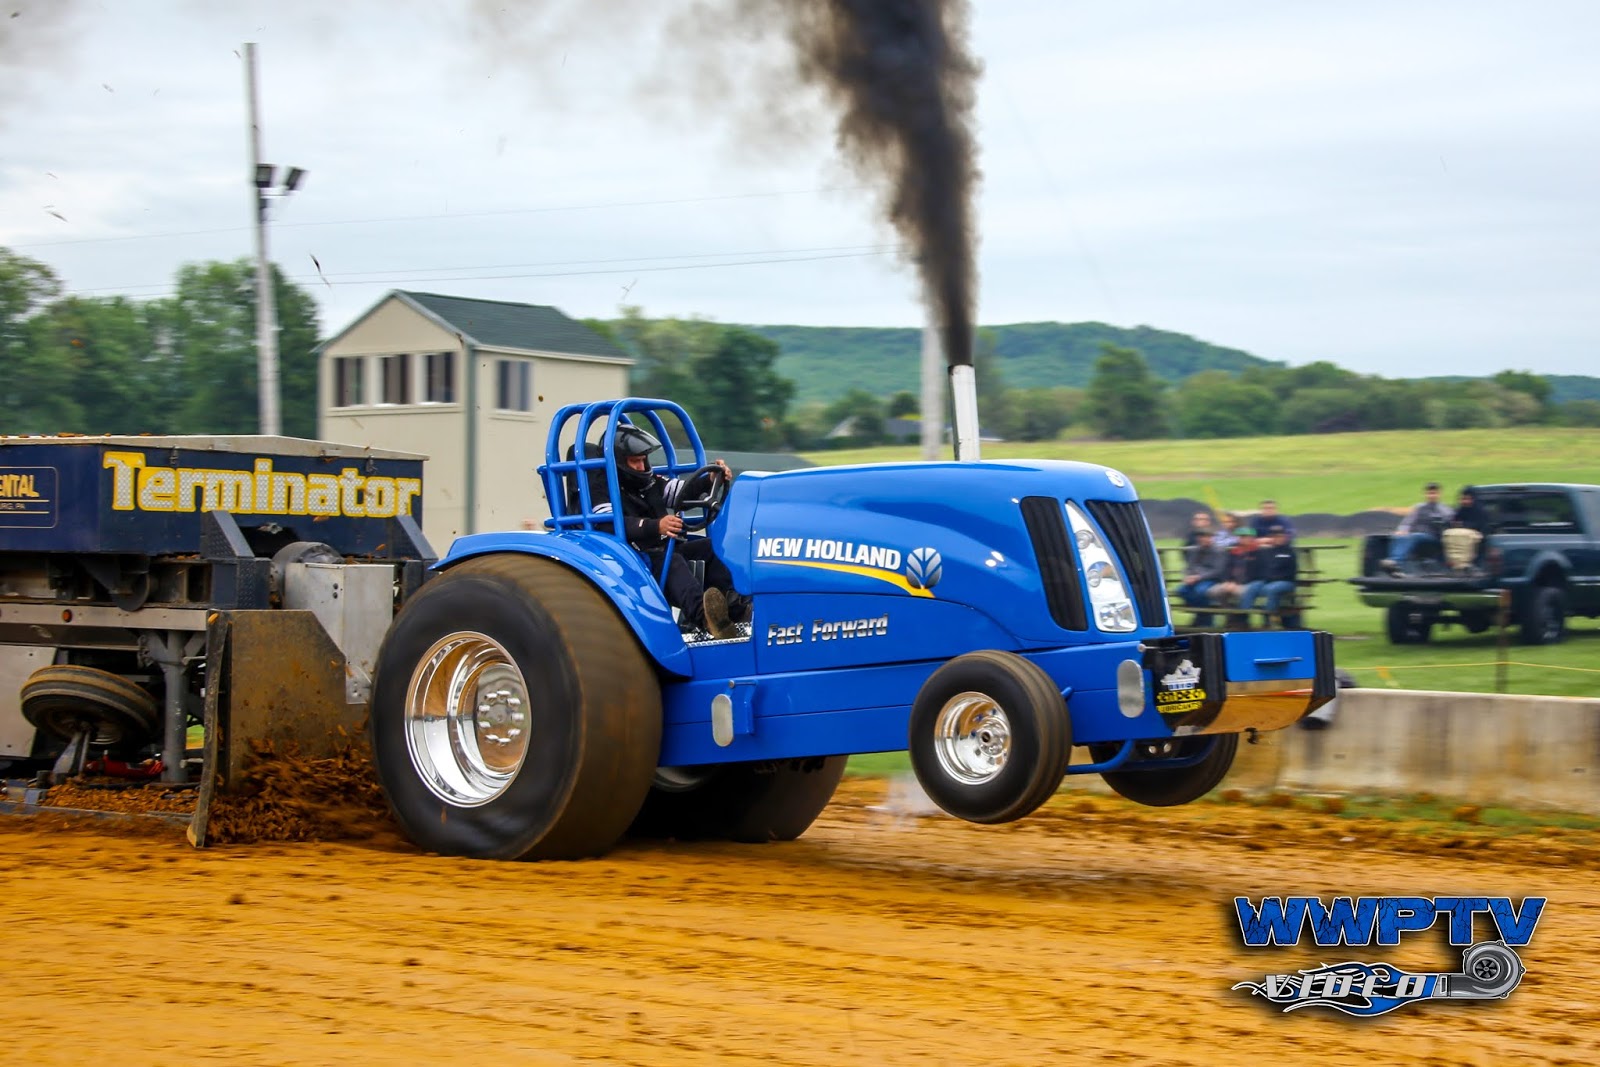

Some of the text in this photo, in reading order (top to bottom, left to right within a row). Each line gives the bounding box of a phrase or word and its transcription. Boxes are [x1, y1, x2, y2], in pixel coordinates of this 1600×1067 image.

[103, 451, 421, 518] Terminator
[757, 537, 901, 570] NEW HOLLAND
[767, 613, 889, 646] Fast Forward
